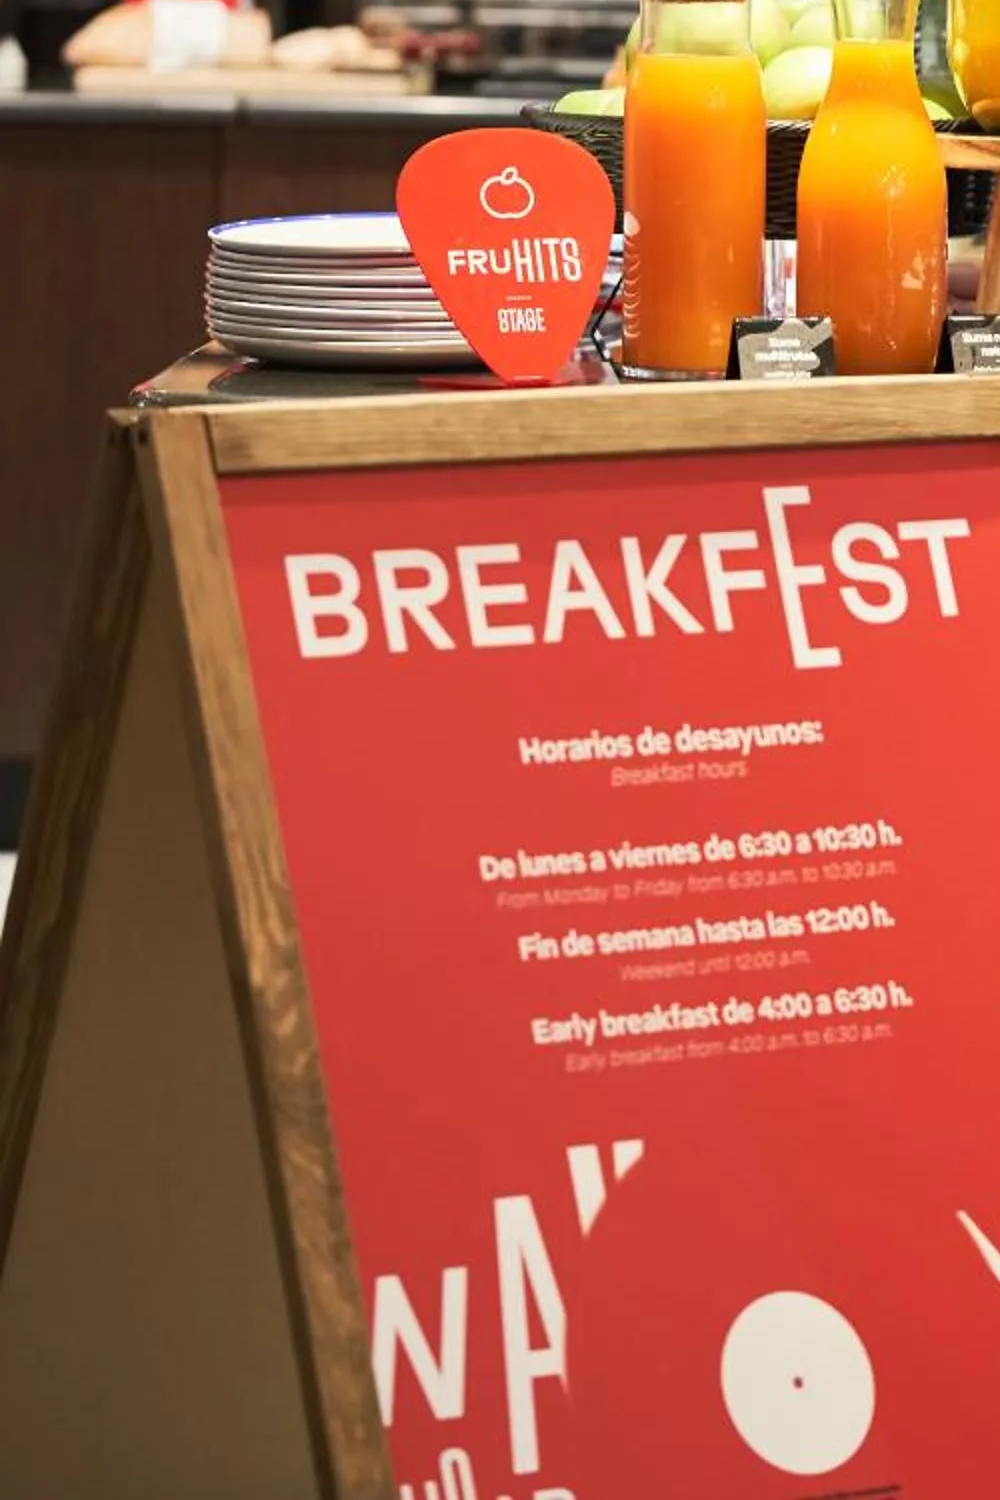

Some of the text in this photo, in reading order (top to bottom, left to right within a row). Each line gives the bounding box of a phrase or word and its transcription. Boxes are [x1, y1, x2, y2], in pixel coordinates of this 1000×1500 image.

[447, 237, 583, 284] FRUHITS
[497, 307, 547, 333] STAGE
[284, 484, 971, 670] BREAKFEST
[518, 721, 824, 765] Horarios de desayunos:
[611, 760, 748, 787] Breakfast hours
[480, 820, 903, 881] De lunes a viernes de 6:30 a 10:30 h.
[544, 885, 608, 905] Monday
[613, 884, 630, 900] to
[634, 879, 684, 900] Friday
[802, 866, 819, 883] to
[518, 899, 896, 962] Fin de semana hasta las 12:00 h.
[531, 980, 914, 1046] Early breakfast de 4:00 a 6:30 h.
[610, 1043, 684, 1068] breakfast
[802, 1030, 820, 1046] to
